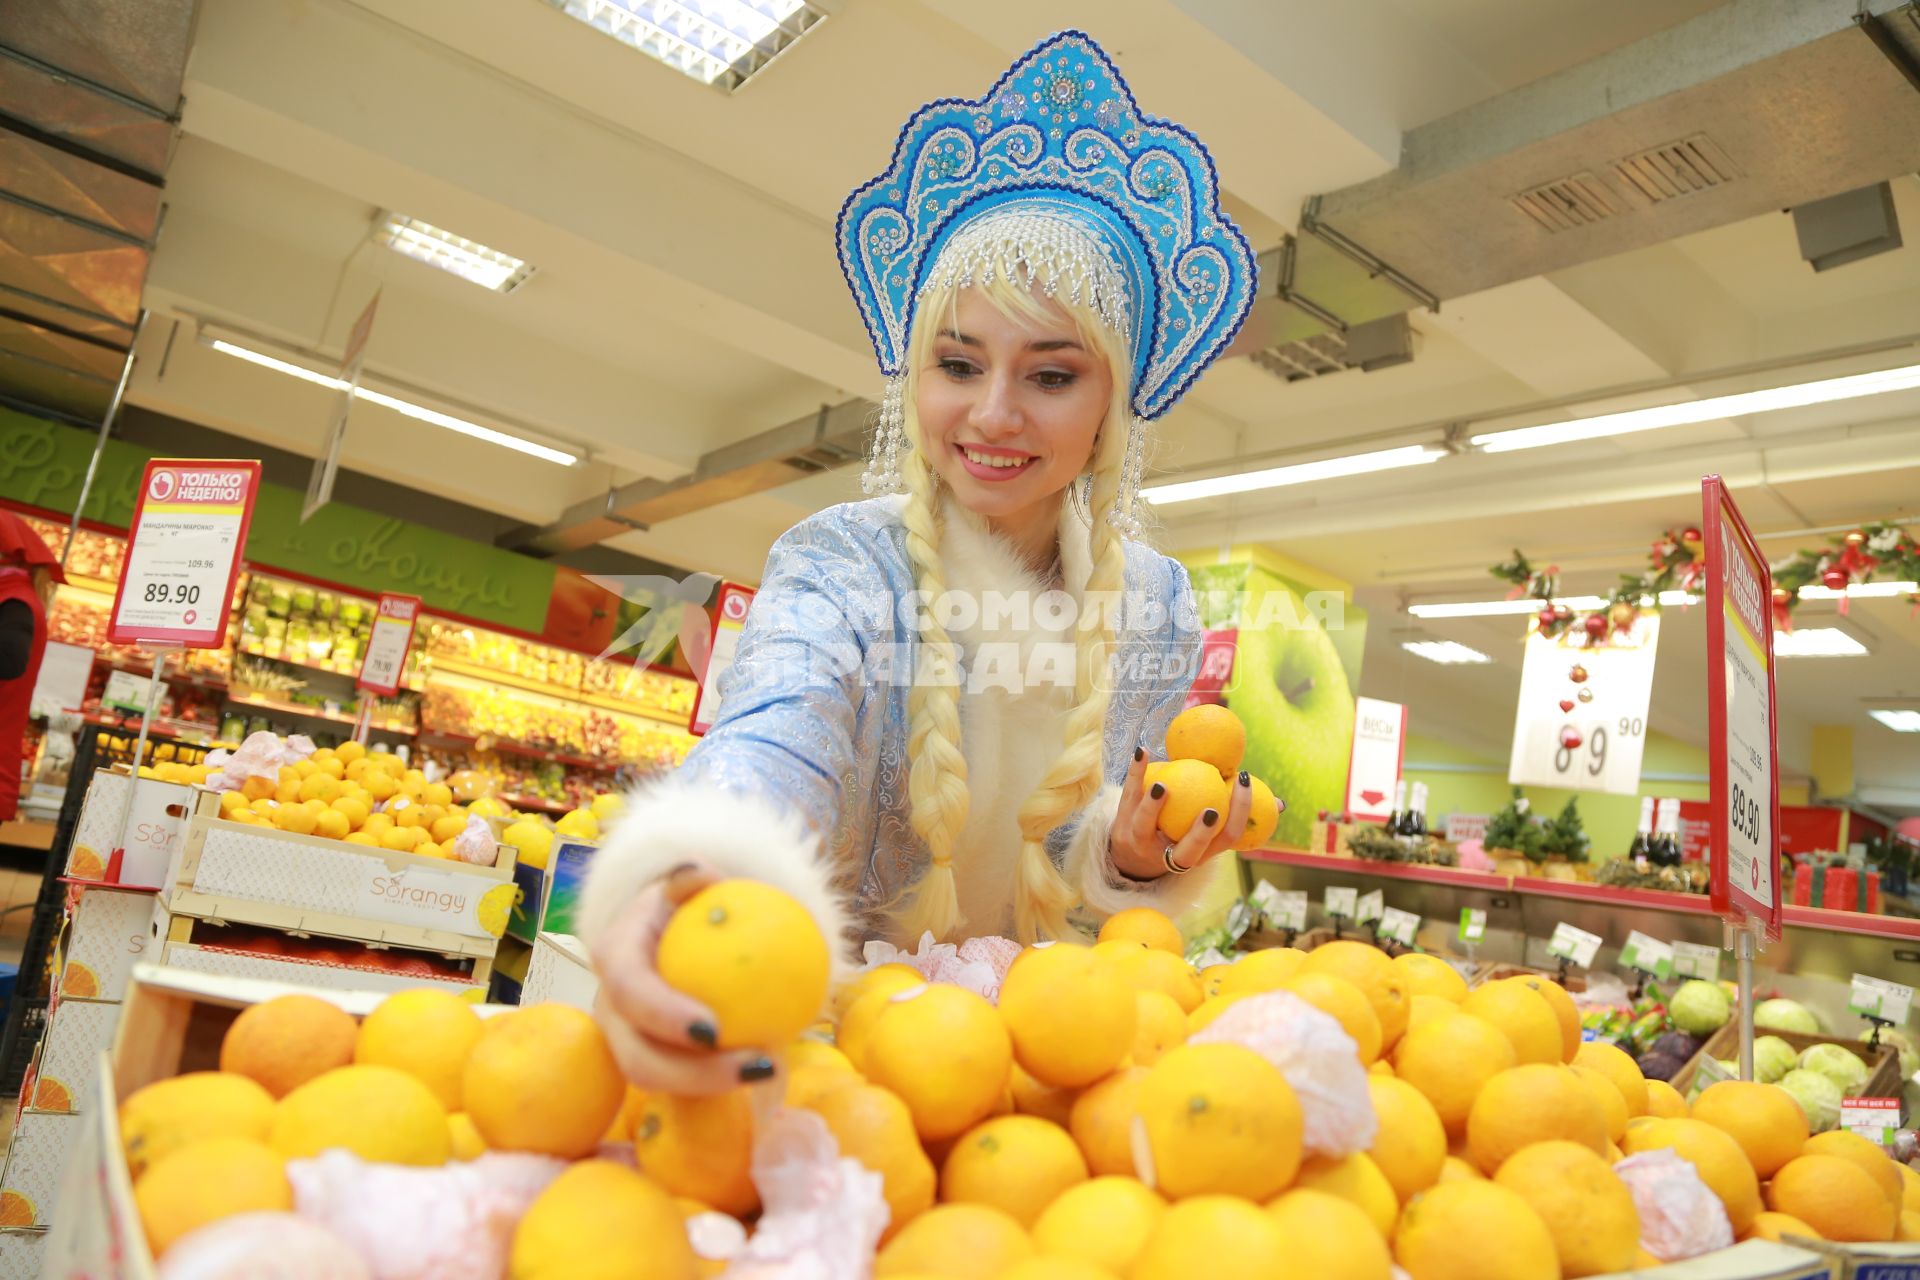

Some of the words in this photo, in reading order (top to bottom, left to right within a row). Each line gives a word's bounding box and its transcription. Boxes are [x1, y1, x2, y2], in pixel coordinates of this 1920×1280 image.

[181, 472, 242, 487] ТОЛЬКО
[177, 486, 241, 501] НЕДЕЛЮ!
[188, 559, 214, 569] 109.96
[327, 518, 517, 611] овощи
[1731, 539, 1760, 609] ТОЛЬКО
[144, 583, 200, 605] 89.90
[1732, 570, 1763, 638] НЕДЕЛЮ!
[1618, 716, 1642, 737] 90
[1732, 783, 1759, 845] 89.90
